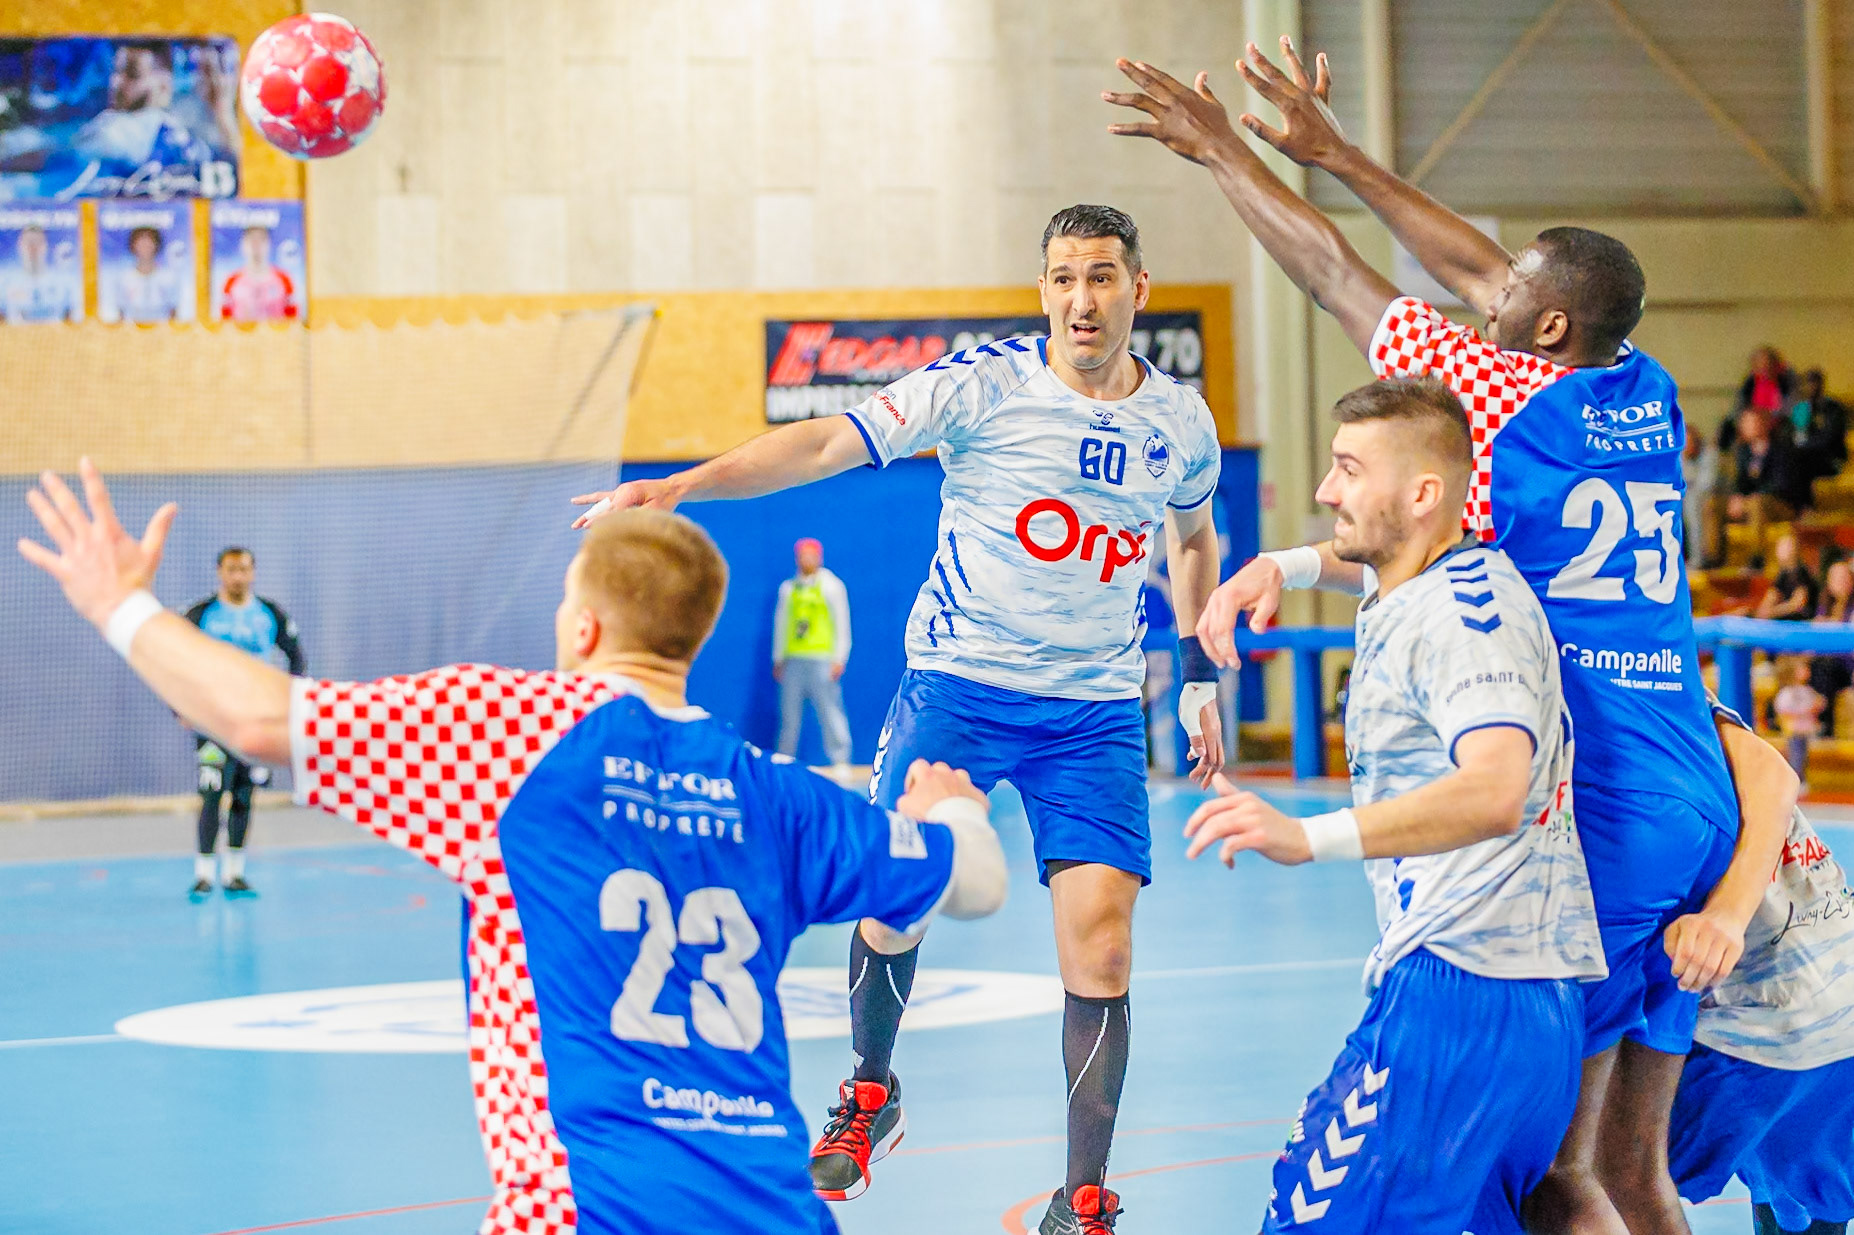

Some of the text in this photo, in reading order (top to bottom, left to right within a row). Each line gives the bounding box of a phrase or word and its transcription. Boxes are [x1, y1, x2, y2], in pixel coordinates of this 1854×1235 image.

[1155, 327, 1202, 373] 70
[1089, 422, 1121, 433] hummel
[1079, 437, 1127, 486] 60
[1015, 498, 1152, 583] Orpi
[1546, 477, 1682, 605] 25
[1560, 643, 1682, 678] Campanile
[1632, 680, 1653, 690] SAINT
[1653, 681, 1682, 692] JACQUES
[599, 868, 763, 1054] 23
